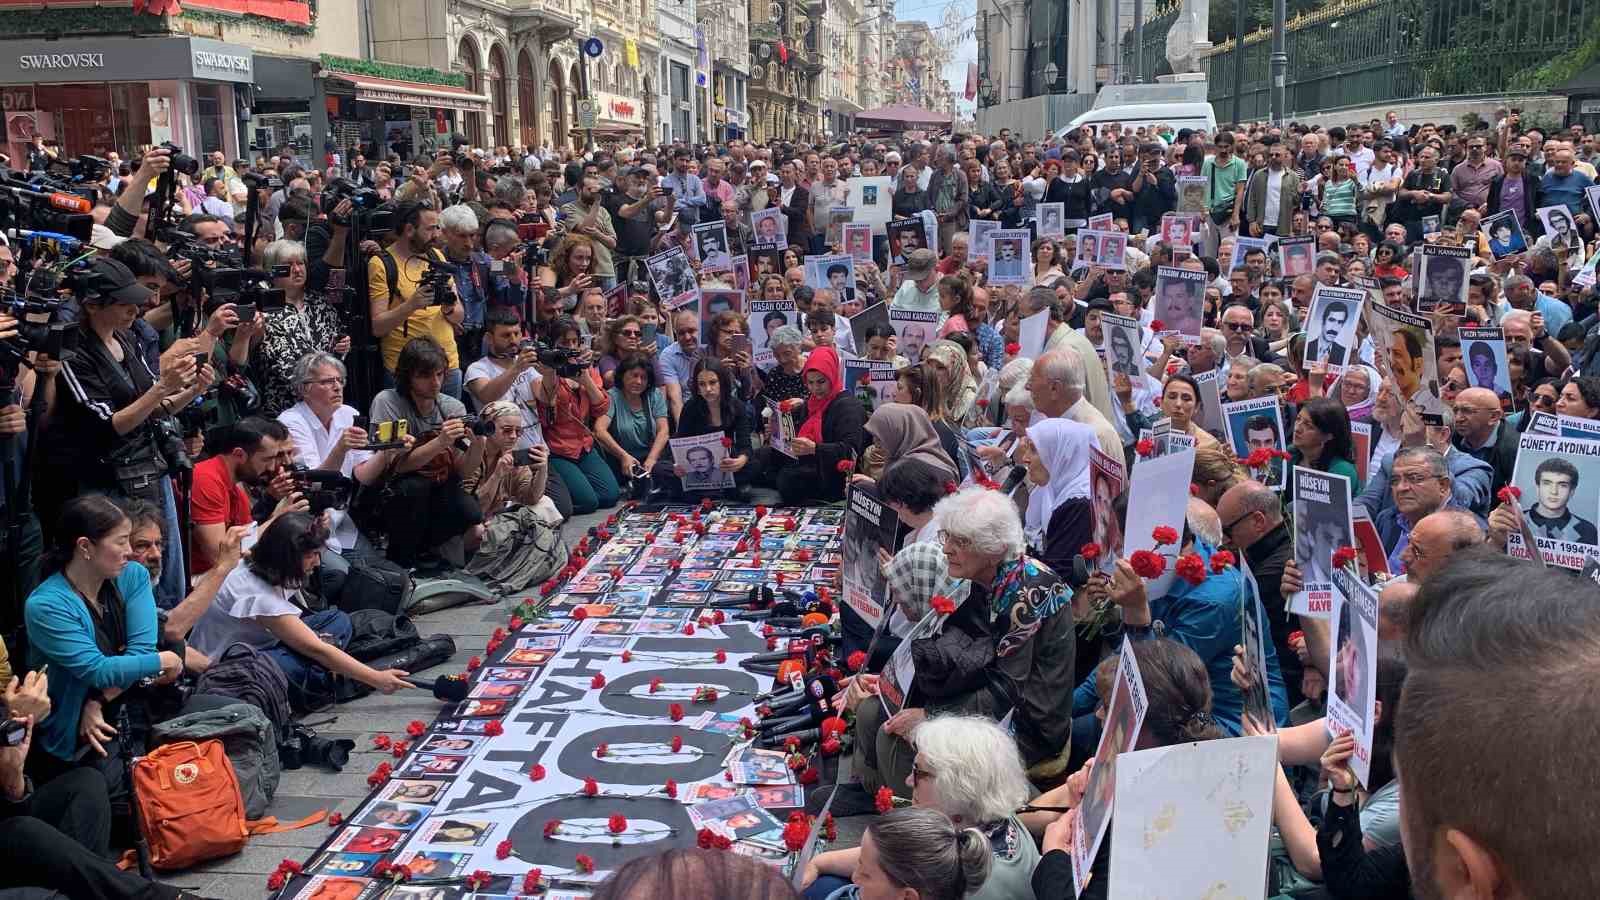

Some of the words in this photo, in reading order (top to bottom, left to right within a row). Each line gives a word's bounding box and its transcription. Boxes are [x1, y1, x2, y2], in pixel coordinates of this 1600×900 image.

[20, 53, 104, 69] SWAROVSKI
[195, 51, 250, 73] SWAROVSKI
[775, 302, 793, 311] OCAK
[1520, 436, 1556, 451] CÜNEYT
[853, 490, 882, 517] HÜSEYİN
[1509, 534, 1521, 545] 28
[445, 649, 612, 812] HAFTA
